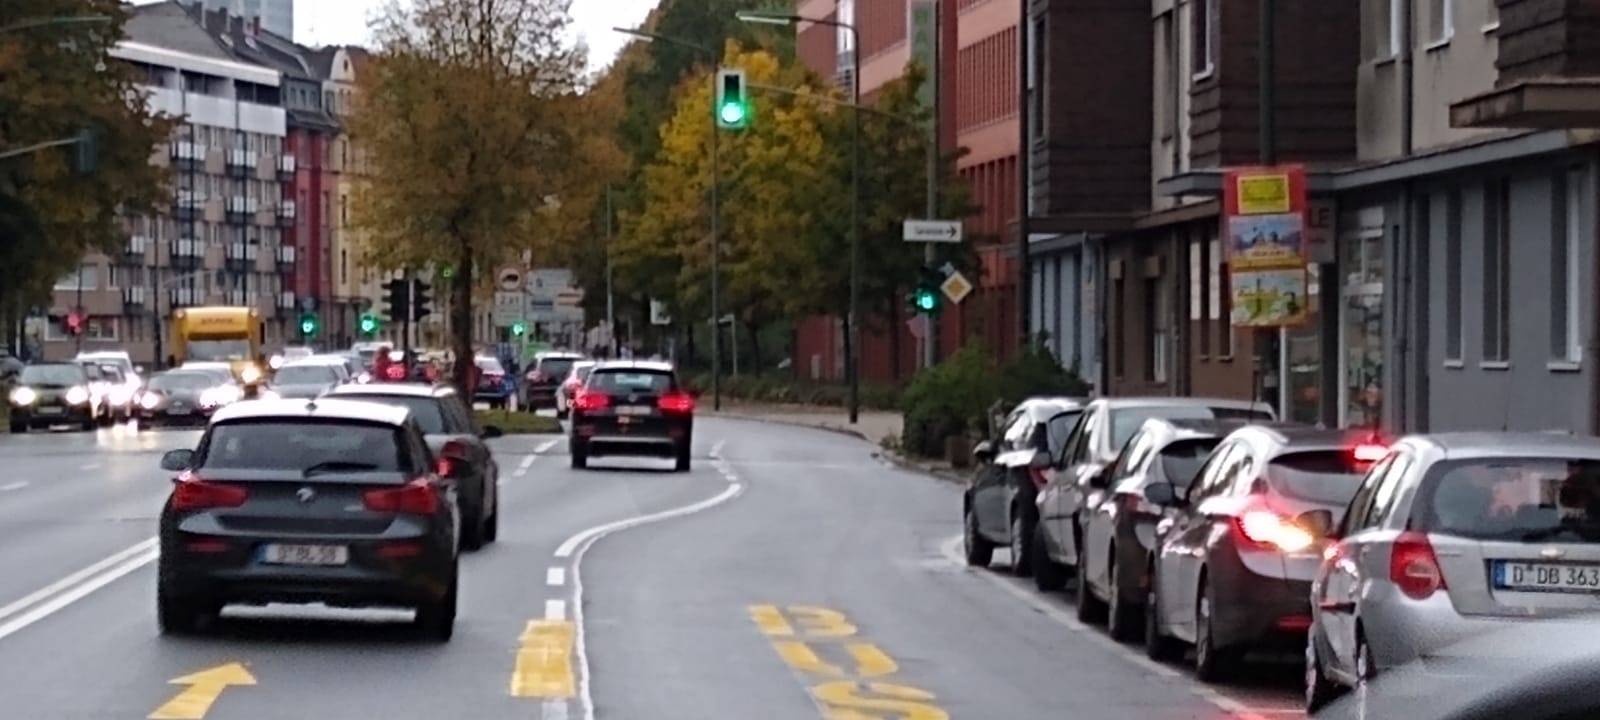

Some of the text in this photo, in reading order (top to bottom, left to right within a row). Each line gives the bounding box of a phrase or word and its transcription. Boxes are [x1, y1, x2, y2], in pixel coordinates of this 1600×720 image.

[1512, 565, 1599, 587] D DB 363
[746, 604, 951, 720] BUS
